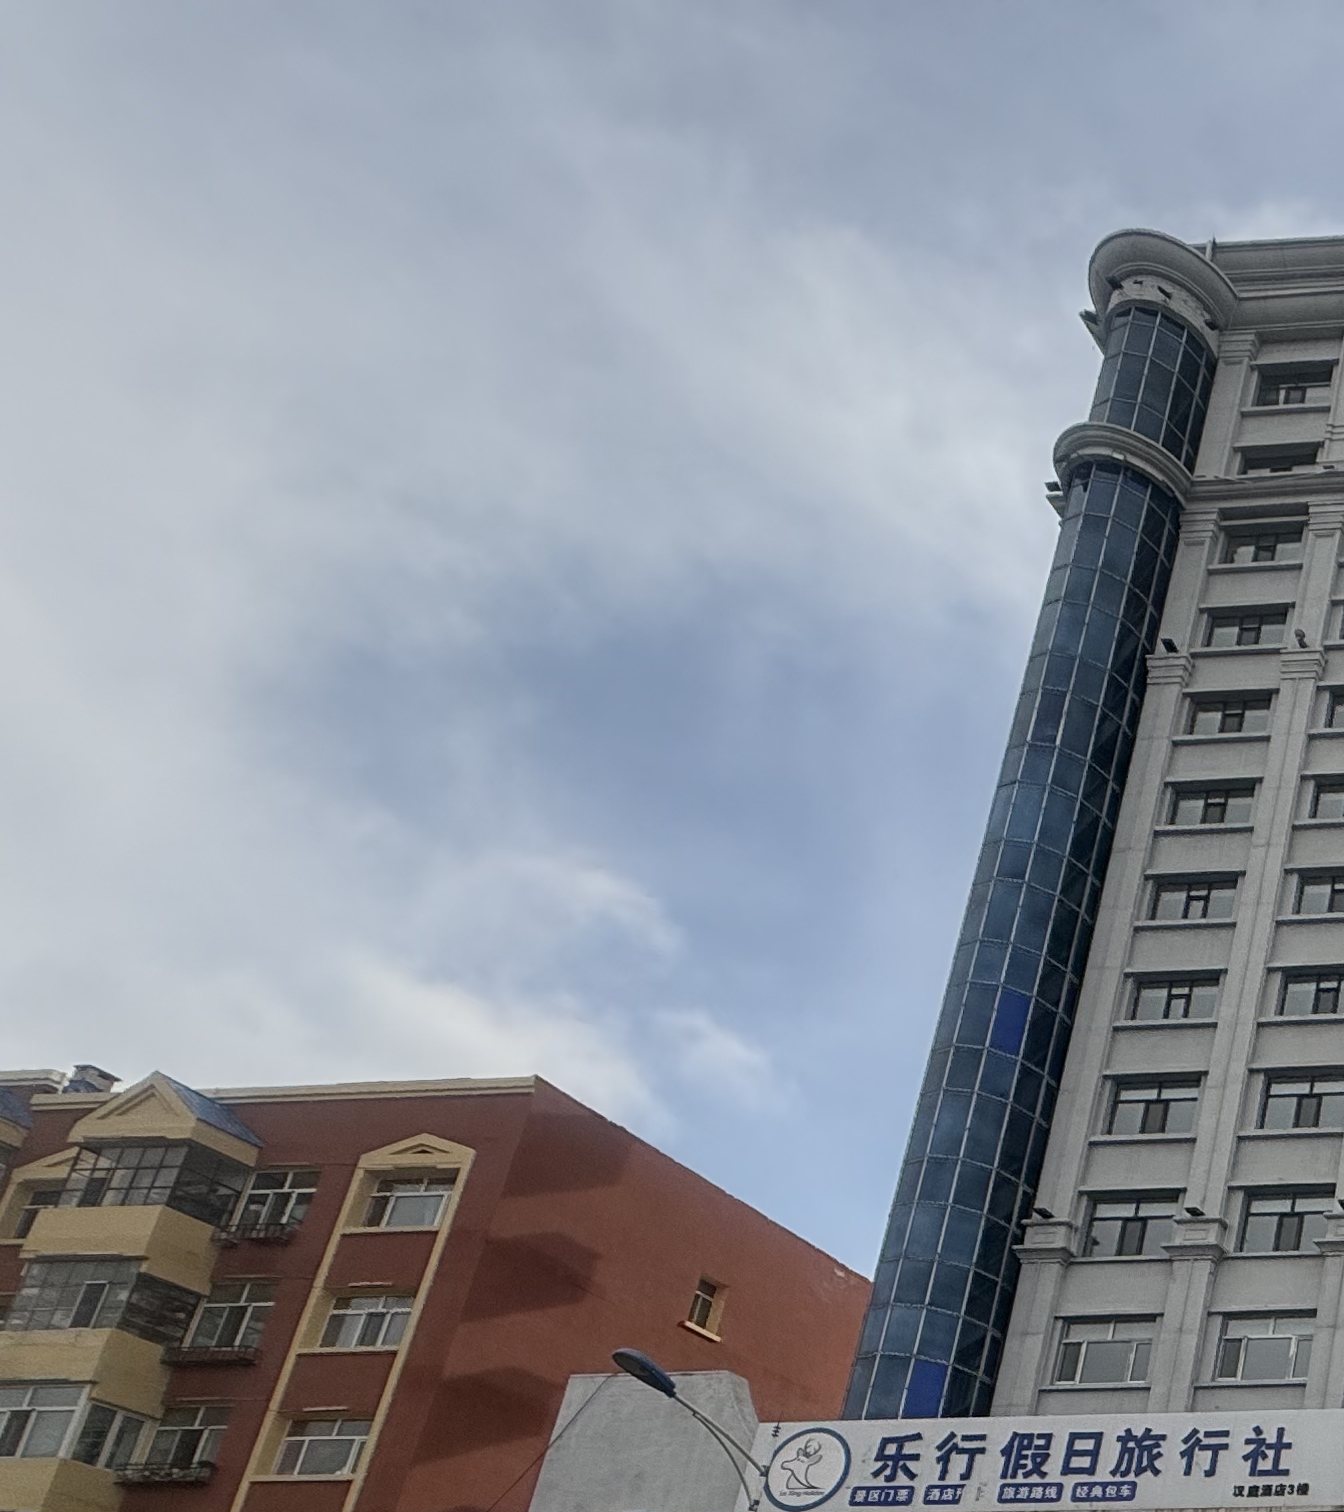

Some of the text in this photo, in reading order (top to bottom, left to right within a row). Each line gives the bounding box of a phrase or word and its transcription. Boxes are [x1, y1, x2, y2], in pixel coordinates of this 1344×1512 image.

[869, 1425, 1293, 1481] 乐行假日旅行社
[852, 1487, 909, 1503] 景区门票
[1001, 1485, 1057, 1500] 旅游路线
[1075, 1483, 1132, 1499] 经典包车
